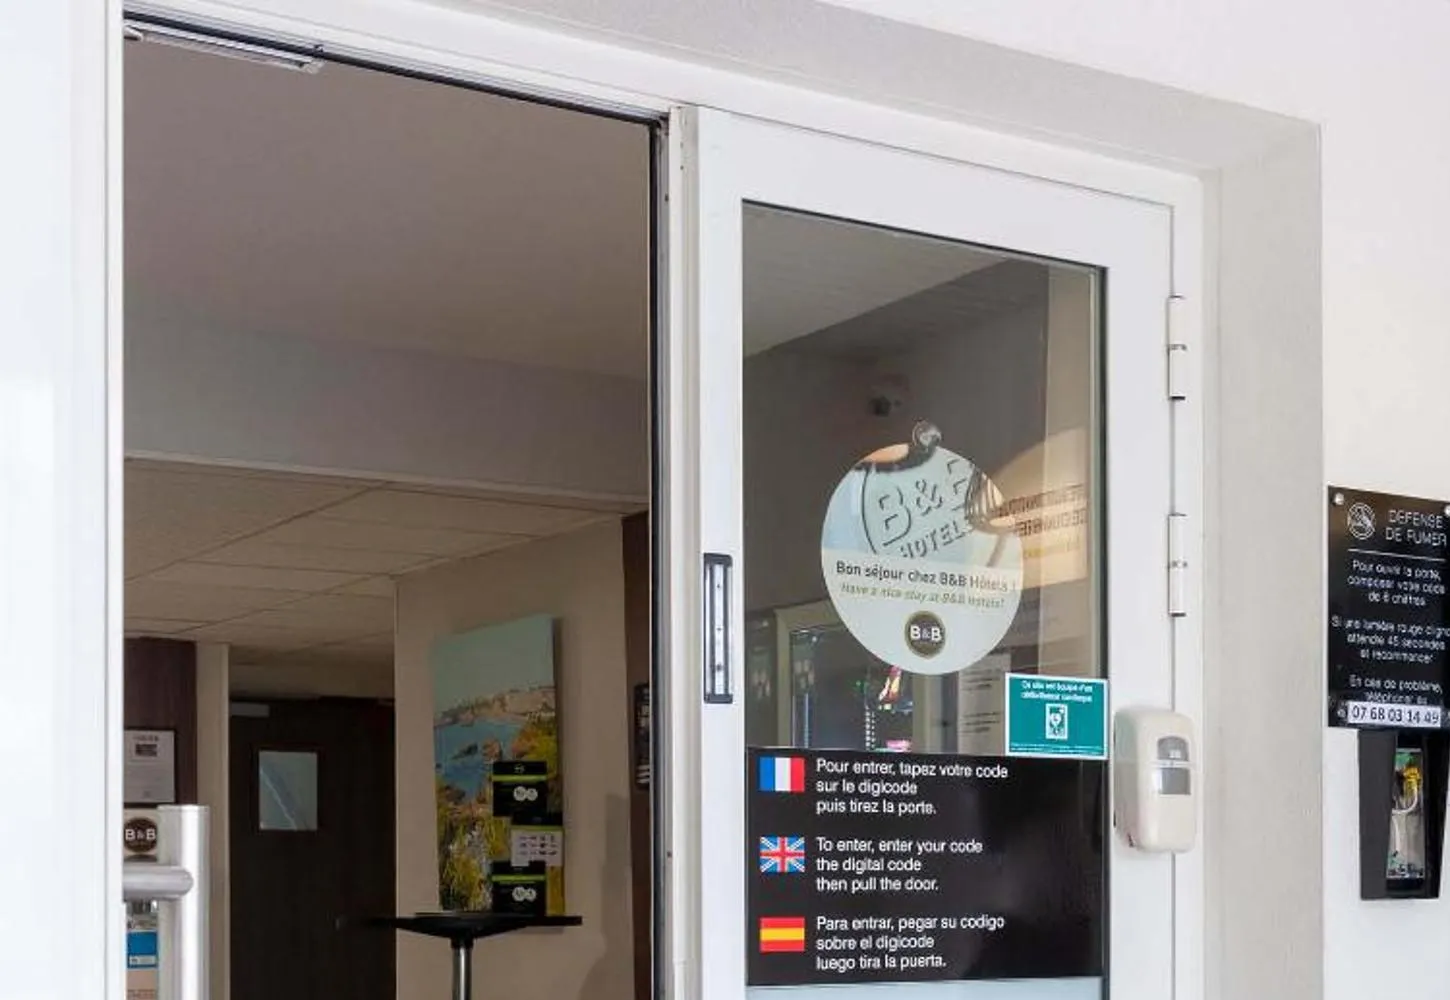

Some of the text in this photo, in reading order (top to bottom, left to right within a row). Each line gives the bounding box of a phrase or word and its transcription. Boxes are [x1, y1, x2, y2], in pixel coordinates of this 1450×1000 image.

[1388, 509, 1443, 529] DEFENSE
[1385, 526, 1447, 547] DE FUMER
[836, 560, 861, 576] Bon
[864, 562, 903, 581] séjour
[907, 568, 937, 585] chez
[939, 571, 967, 587] B&B
[1352, 559, 1374, 572] Pour
[909, 625, 943, 642] B&B
[1352, 705, 1367, 720] 07
[1370, 706, 1386, 721] 68
[1388, 708, 1403, 722] 03
[1406, 709, 1421, 723] 14
[816, 758, 1009, 779] Pour entrer, tapez votre code
[816, 779, 918, 798] sur le digicode
[816, 799, 937, 817] puis tirez la porte.
[124, 827, 157, 842] B&B
[816, 836, 984, 856] To enter, enter your code
[816, 857, 923, 875] the digital code
[816, 877, 940, 894] then pull the door.
[816, 914, 1005, 934] Para entrar, pegar su codigo
[816, 934, 935, 952] sobre el digicode
[816, 954, 947, 973] luego tira la puerta.
